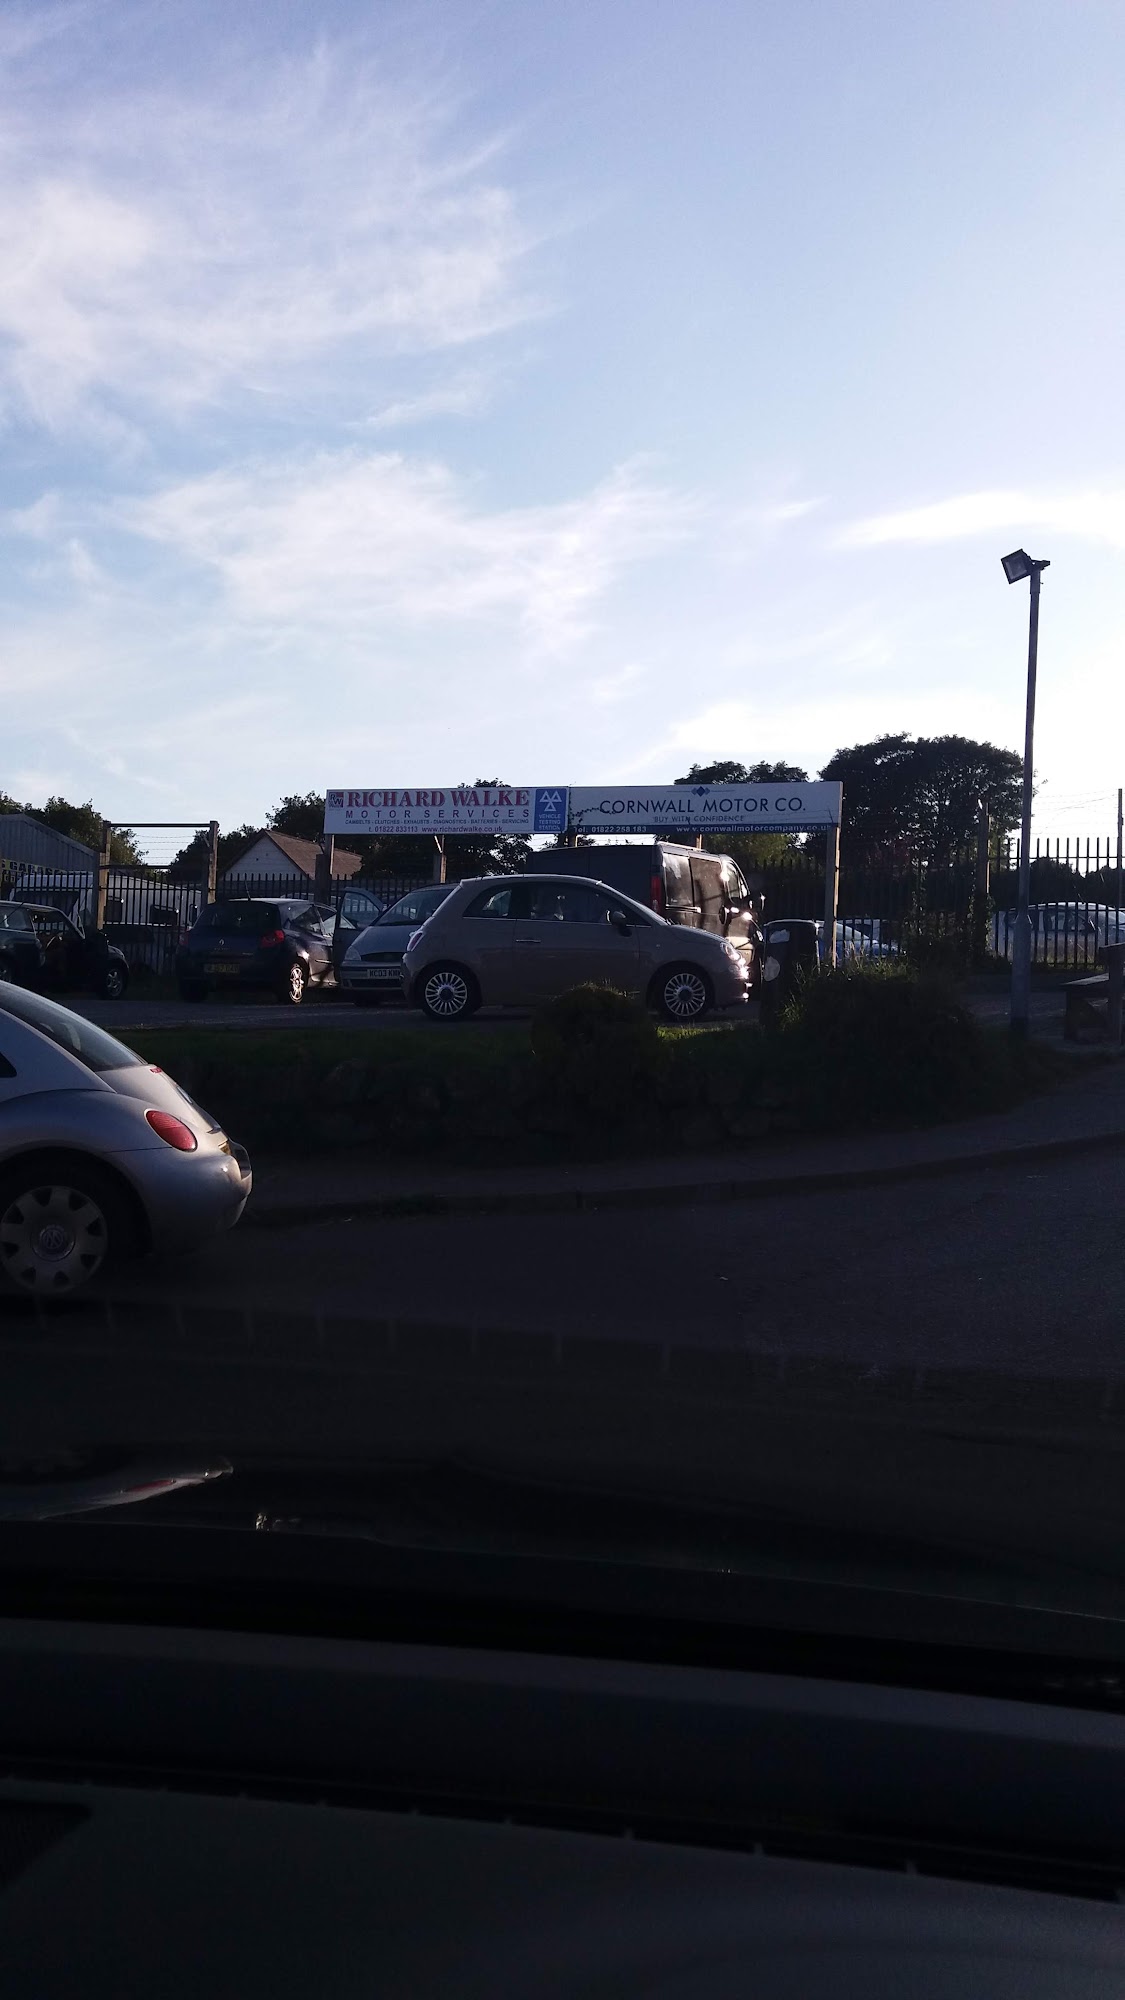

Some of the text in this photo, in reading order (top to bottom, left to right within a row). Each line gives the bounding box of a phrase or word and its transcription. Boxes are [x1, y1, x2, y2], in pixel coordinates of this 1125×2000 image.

[347, 791, 446, 808] RICHARD
[451, 790, 530, 807] WALKE
[600, 797, 806, 814] CORNWALL MOTOR CO.
[346, 809, 529, 818] MOTOR SERVICES
[421, 825, 503, 833] www.richardwalke.co.uk
